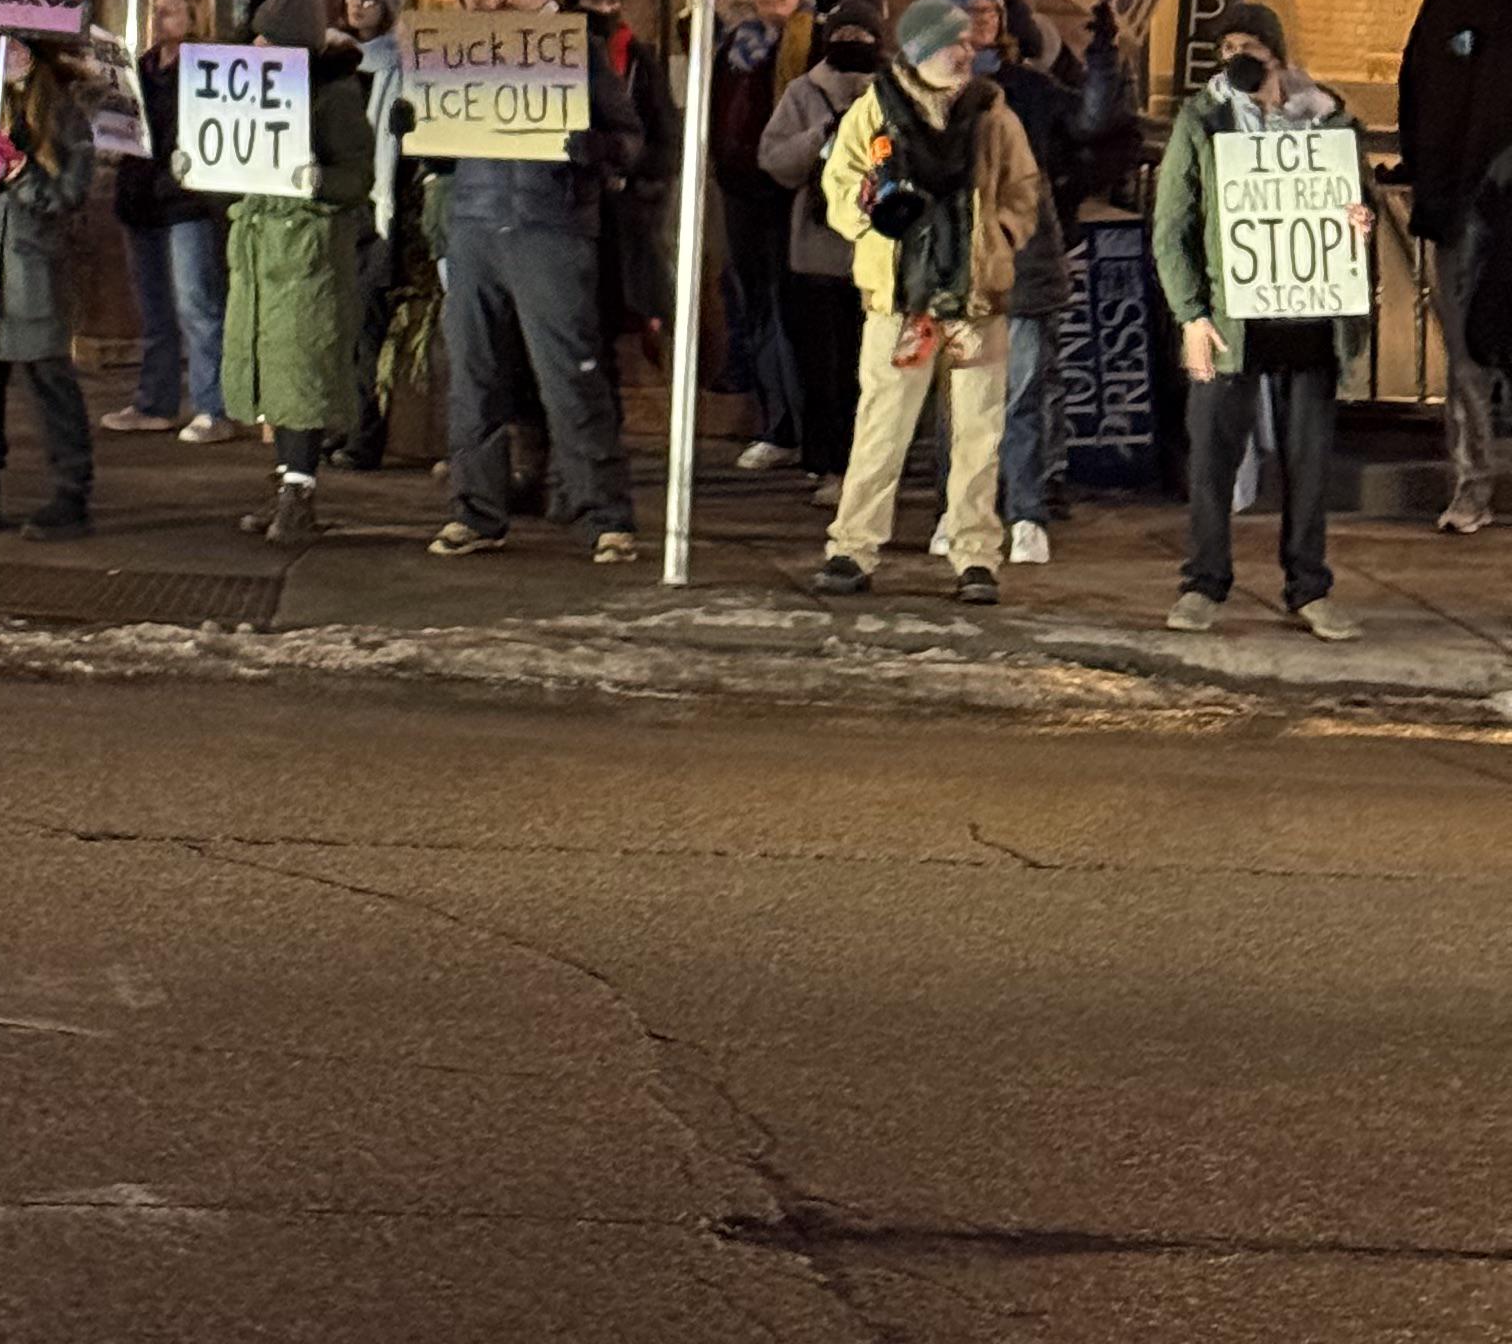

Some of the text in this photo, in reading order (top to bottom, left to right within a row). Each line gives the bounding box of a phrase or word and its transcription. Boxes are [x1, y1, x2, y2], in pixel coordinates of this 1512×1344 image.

[515, 28, 581, 69] ICE
[414, 82, 577, 128] ICE OUT
[198, 117, 291, 170] OUT
[1248, 133, 1326, 173] ICE
[1294, 176, 1353, 211] READ
[1255, 284, 1343, 313] SIGNS
[1096, 296, 1154, 458] PRESS
